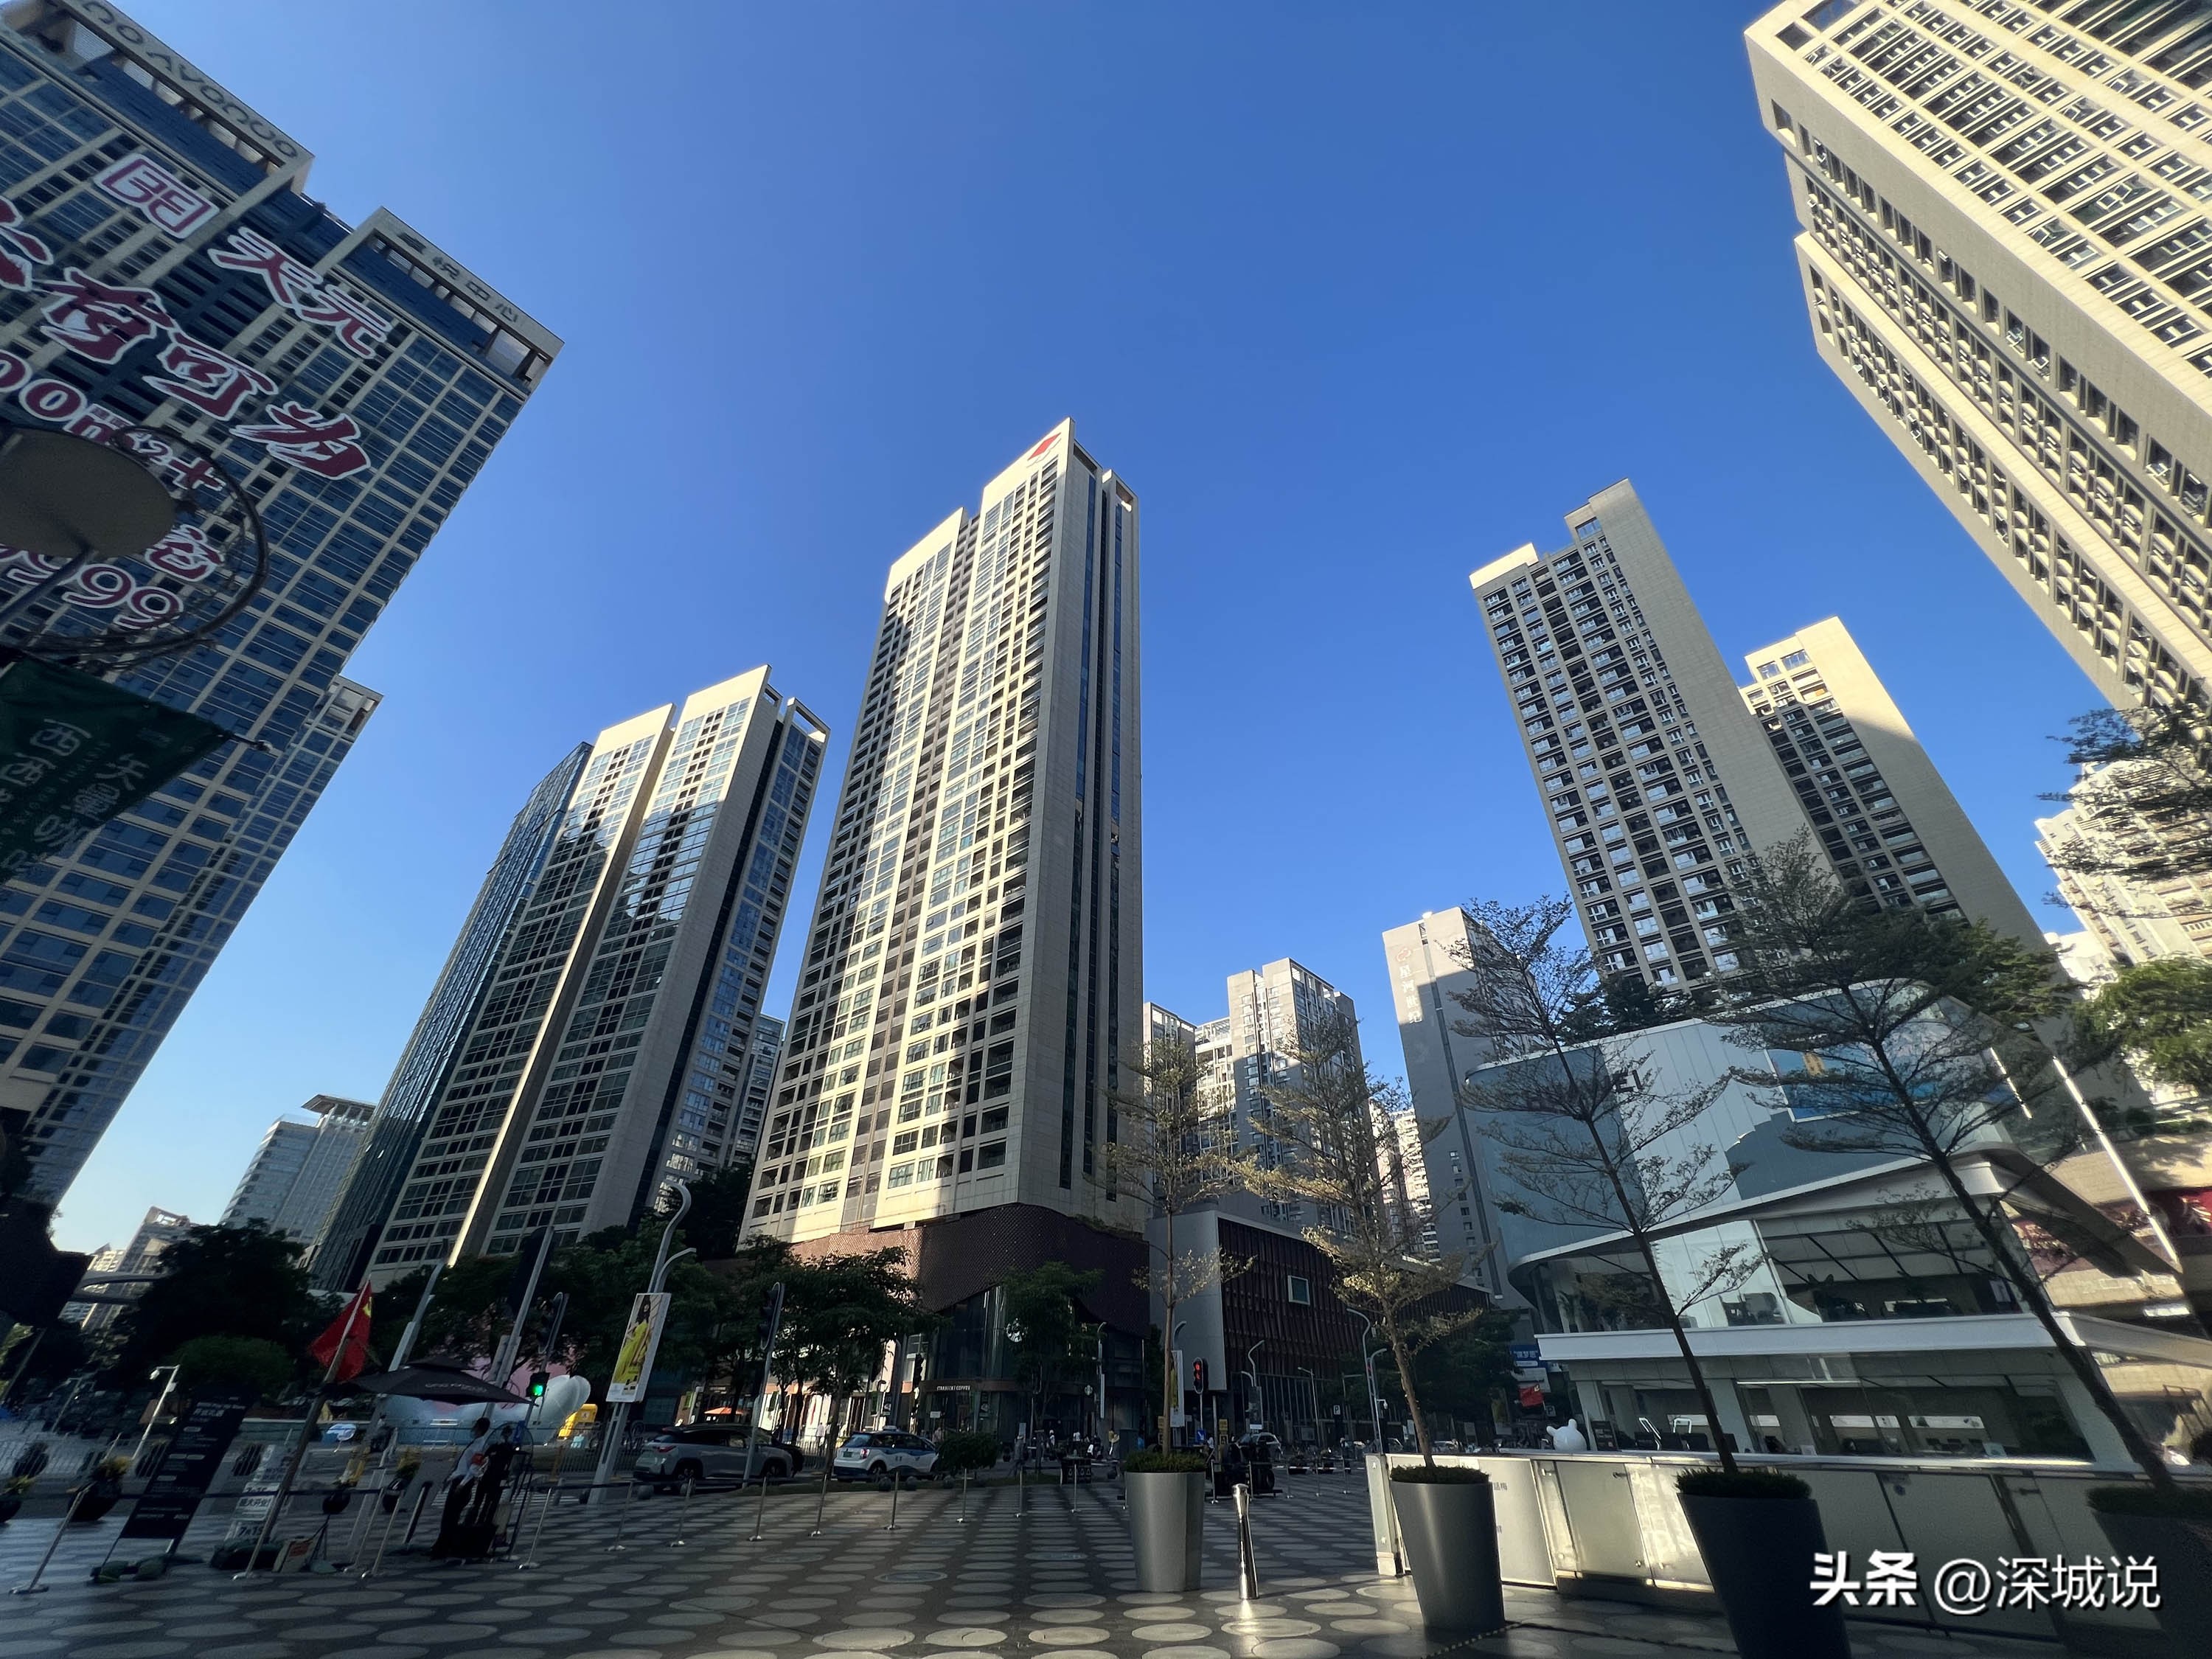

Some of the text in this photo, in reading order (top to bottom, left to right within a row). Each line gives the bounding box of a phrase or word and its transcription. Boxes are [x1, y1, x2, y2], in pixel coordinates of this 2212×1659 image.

[207, 226, 394, 359] 天元
[1399, 964, 1422, 1023] 星河世纪
